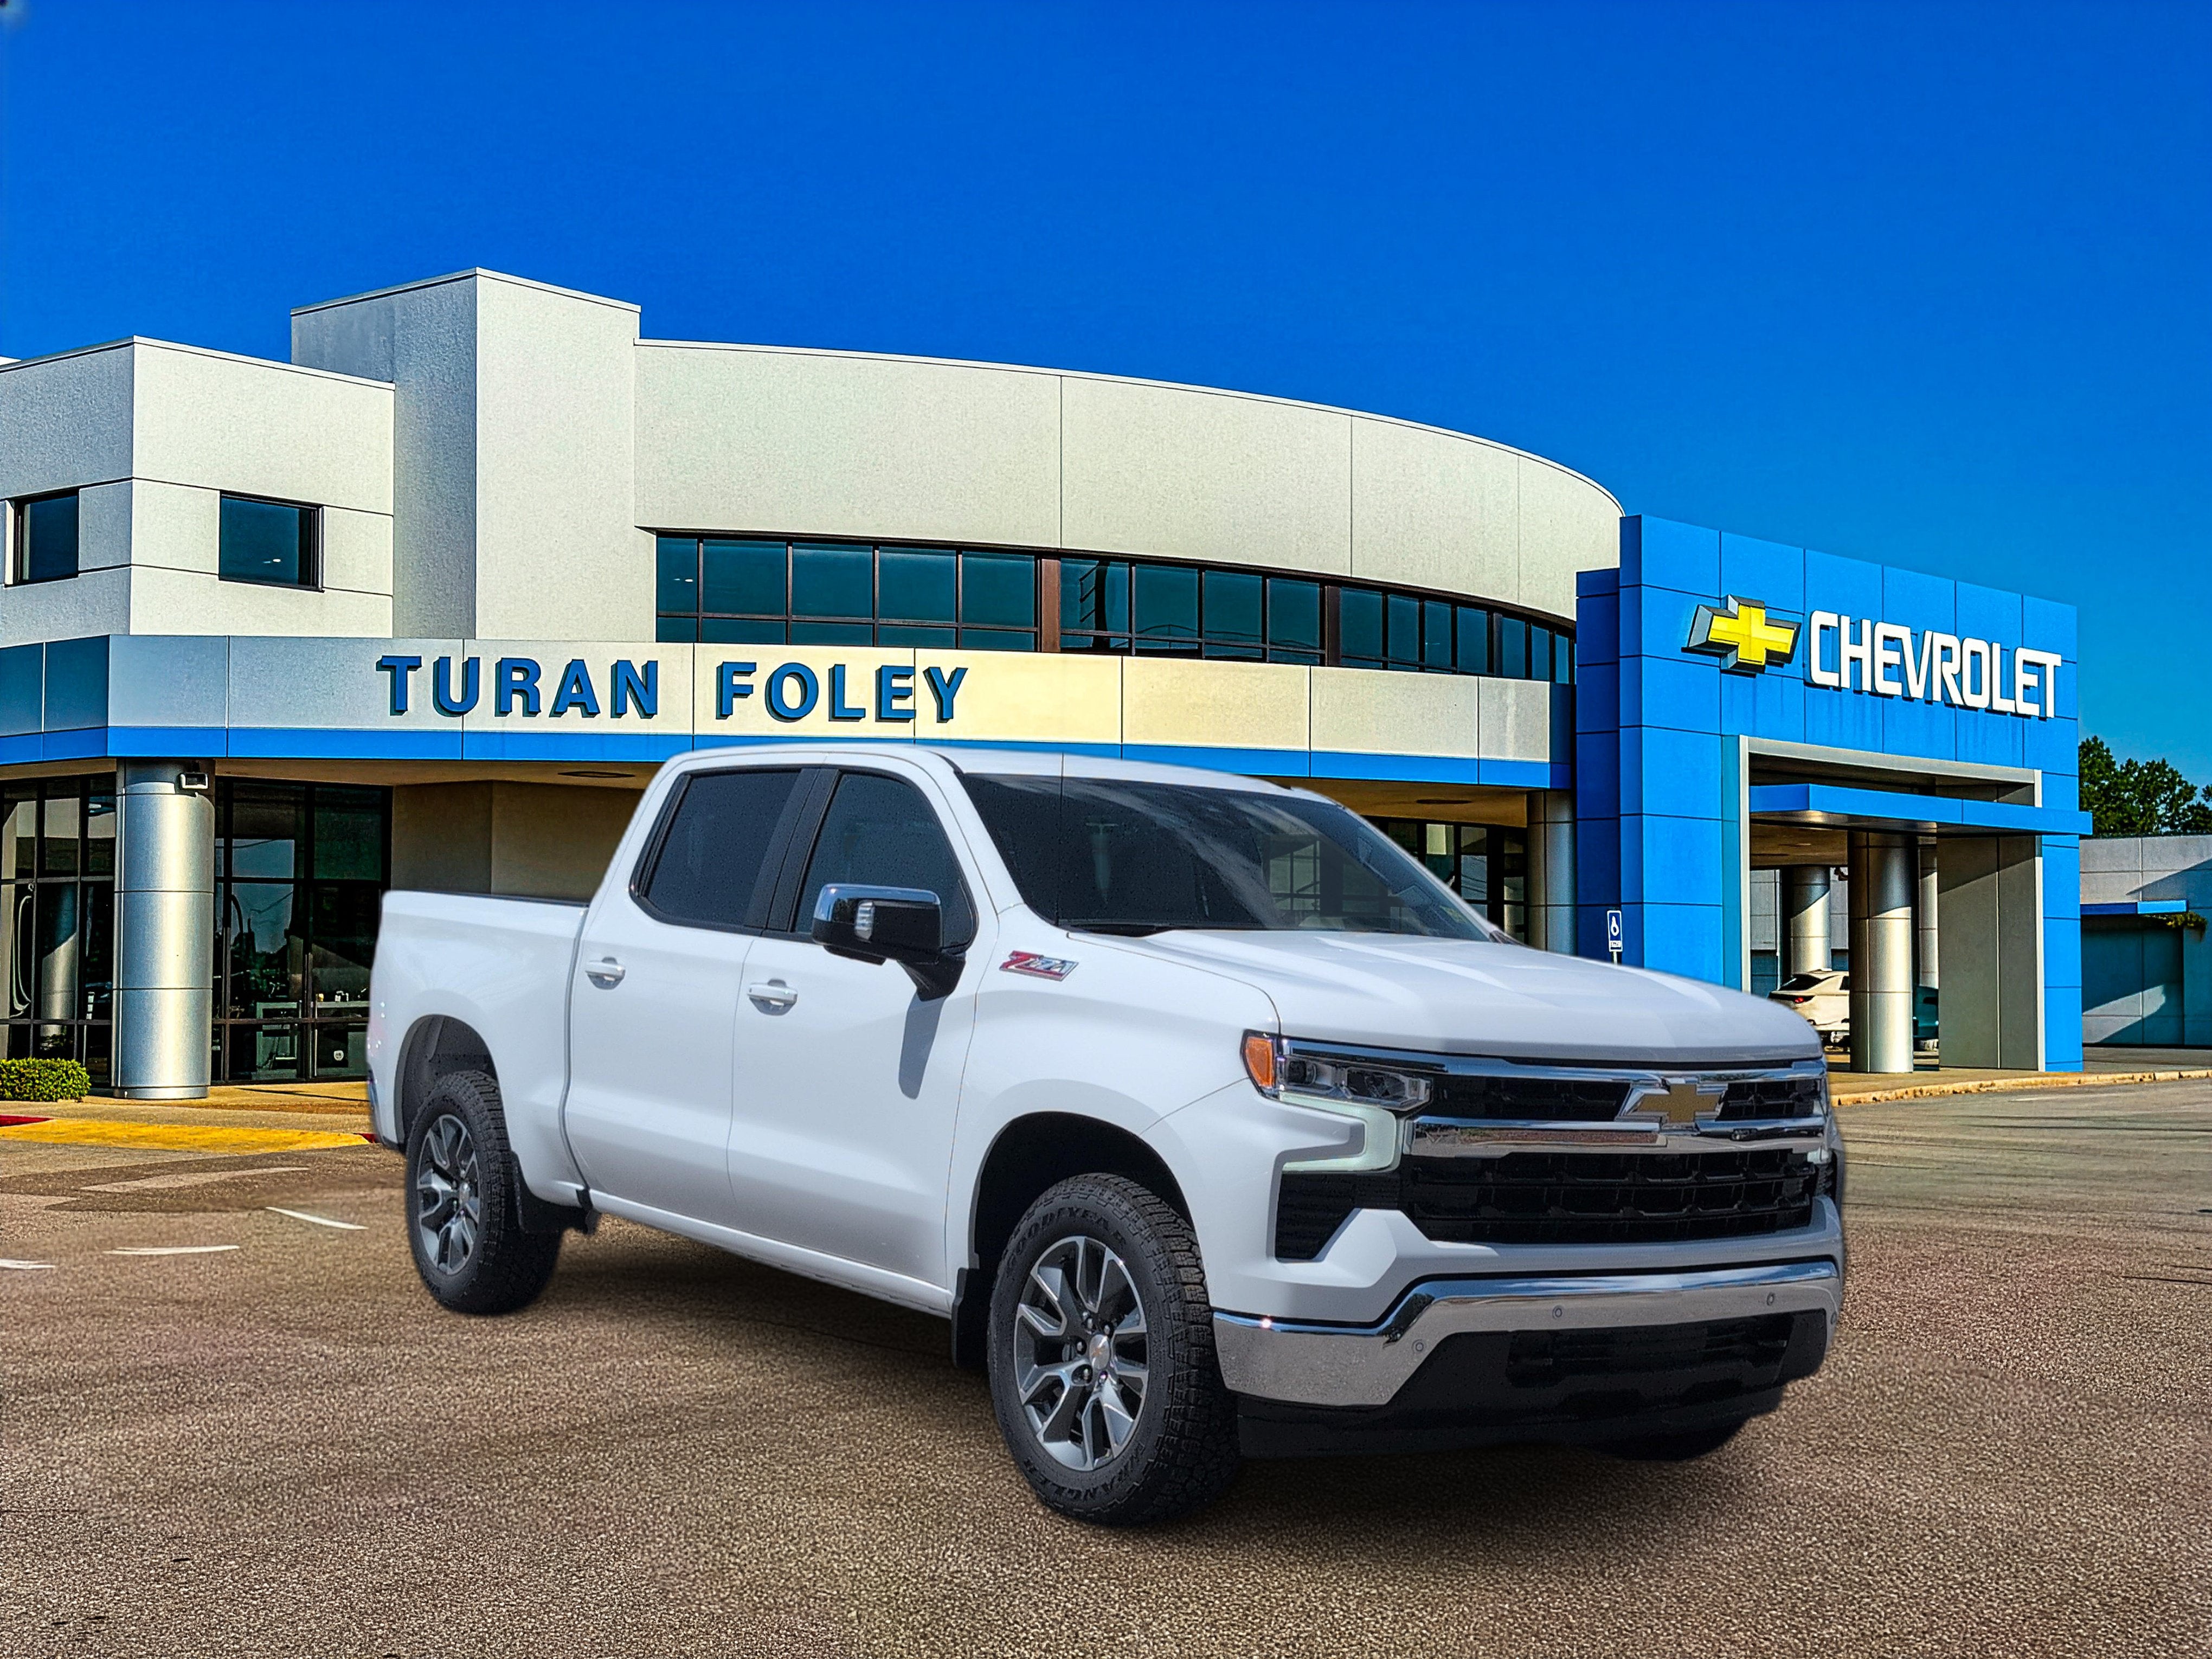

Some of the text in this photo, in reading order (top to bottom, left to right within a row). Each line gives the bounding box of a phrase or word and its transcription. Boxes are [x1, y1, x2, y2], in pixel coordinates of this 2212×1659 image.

[376, 655, 969, 723] TURAN FOLEY
[1809, 610, 2062, 718] CHEVROLET
[1006, 1206, 1127, 1269] GOODYEAR
